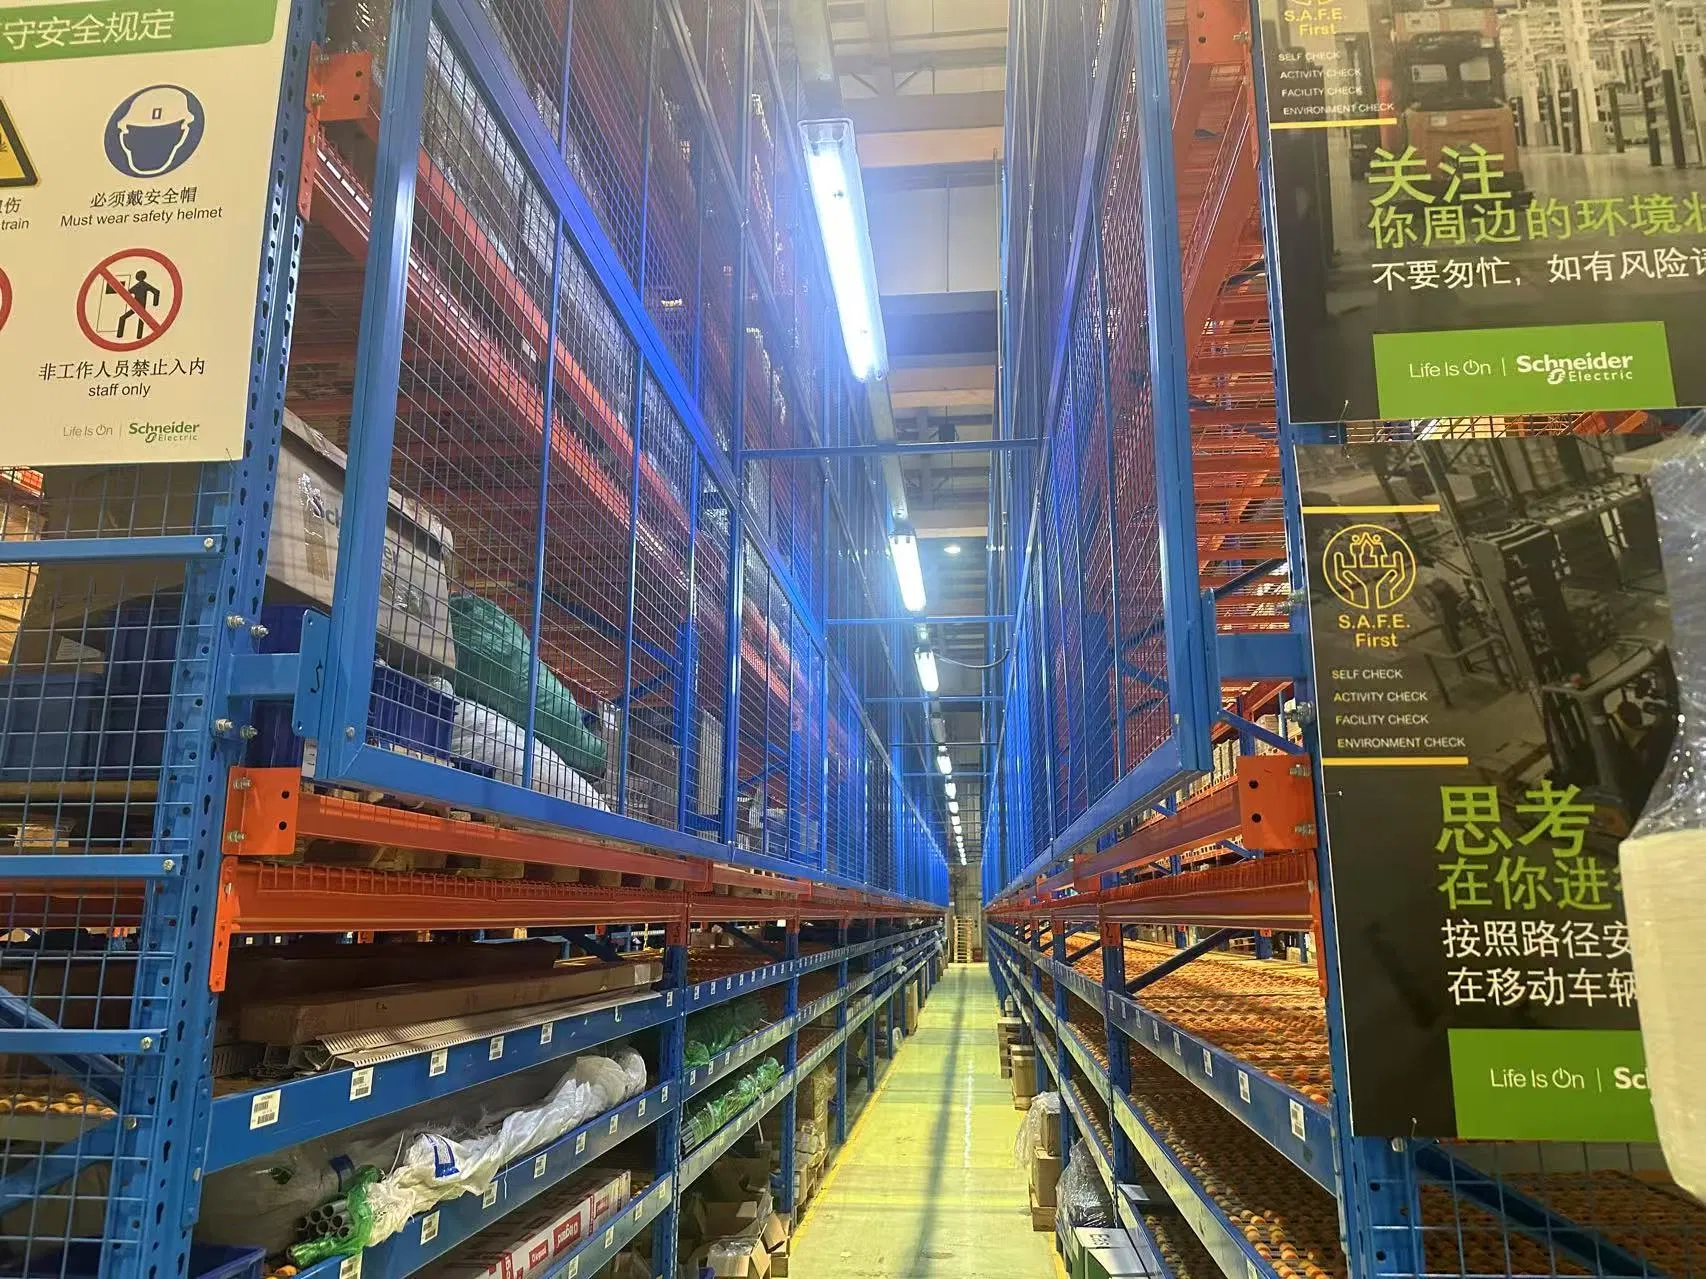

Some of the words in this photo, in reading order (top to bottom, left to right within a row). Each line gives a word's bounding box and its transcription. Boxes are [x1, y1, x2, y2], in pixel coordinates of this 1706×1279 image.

[0, 9, 175, 50] 守安全规定
[1299, 23, 1336, 37] First
[1278, 53, 1301, 62] SELF
[1304, 52, 1340, 61] CHECK
[1279, 69, 1324, 80] ACTIVITY
[1326, 68, 1361, 77] CHECK
[1281, 88, 1325, 97] FACILITY
[1327, 86, 1363, 96] CHECK
[1283, 104, 1356, 115] ENVIRONMENT
[1358, 103, 1394, 112] CHECK
[1368, 143, 1512, 208] 关注
[90, 186, 197, 208] 必须戴安全帽
[0, 197, 21, 214] 伤
[60, 214, 93, 227] Must
[96, 216, 129, 225] wear
[132, 211, 172, 225] safety
[177, 207, 222, 220] helmet
[38, 357, 205, 381] 非工作人员禁止入内
[1409, 361, 1441, 378] Life
[1445, 361, 1460, 376] Is
[1463, 359, 1491, 376] On
[1516, 351, 1634, 374] Schneider
[1569, 369, 1633, 382] Electric
[88, 383, 119, 397] staff
[121, 384, 150, 398] only
[63, 426, 83, 437] Life
[84, 426, 94, 436] Is
[96, 424, 113, 436] On
[129, 421, 200, 435] Schneider
[158, 433, 198, 442] Electric
[1338, 614, 1411, 629] S.A.F.E.
[1355, 632, 1399, 648] First
[1332, 670, 1359, 680] SELF
[1362, 669, 1403, 680] CHECK
[1333, 692, 1384, 702] ACTIVITY
[1387, 691, 1428, 702] CHECK
[1335, 715, 1385, 725] FACILITY
[1387, 714, 1429, 725] CHECK
[1337, 738, 1421, 748] ENVIRONMENT
[1424, 736, 1466, 747] CHECK
[1435, 780, 1595, 858] 思考
[1438, 856, 1623, 910] 在你进
[1441, 918, 1632, 959] 按照路径安
[1447, 966, 1638, 1007] 在移动车辆
[1490, 1068, 1526, 1087] Life
[1531, 1069, 1548, 1088] Is
[1552, 1067, 1585, 1089] On
